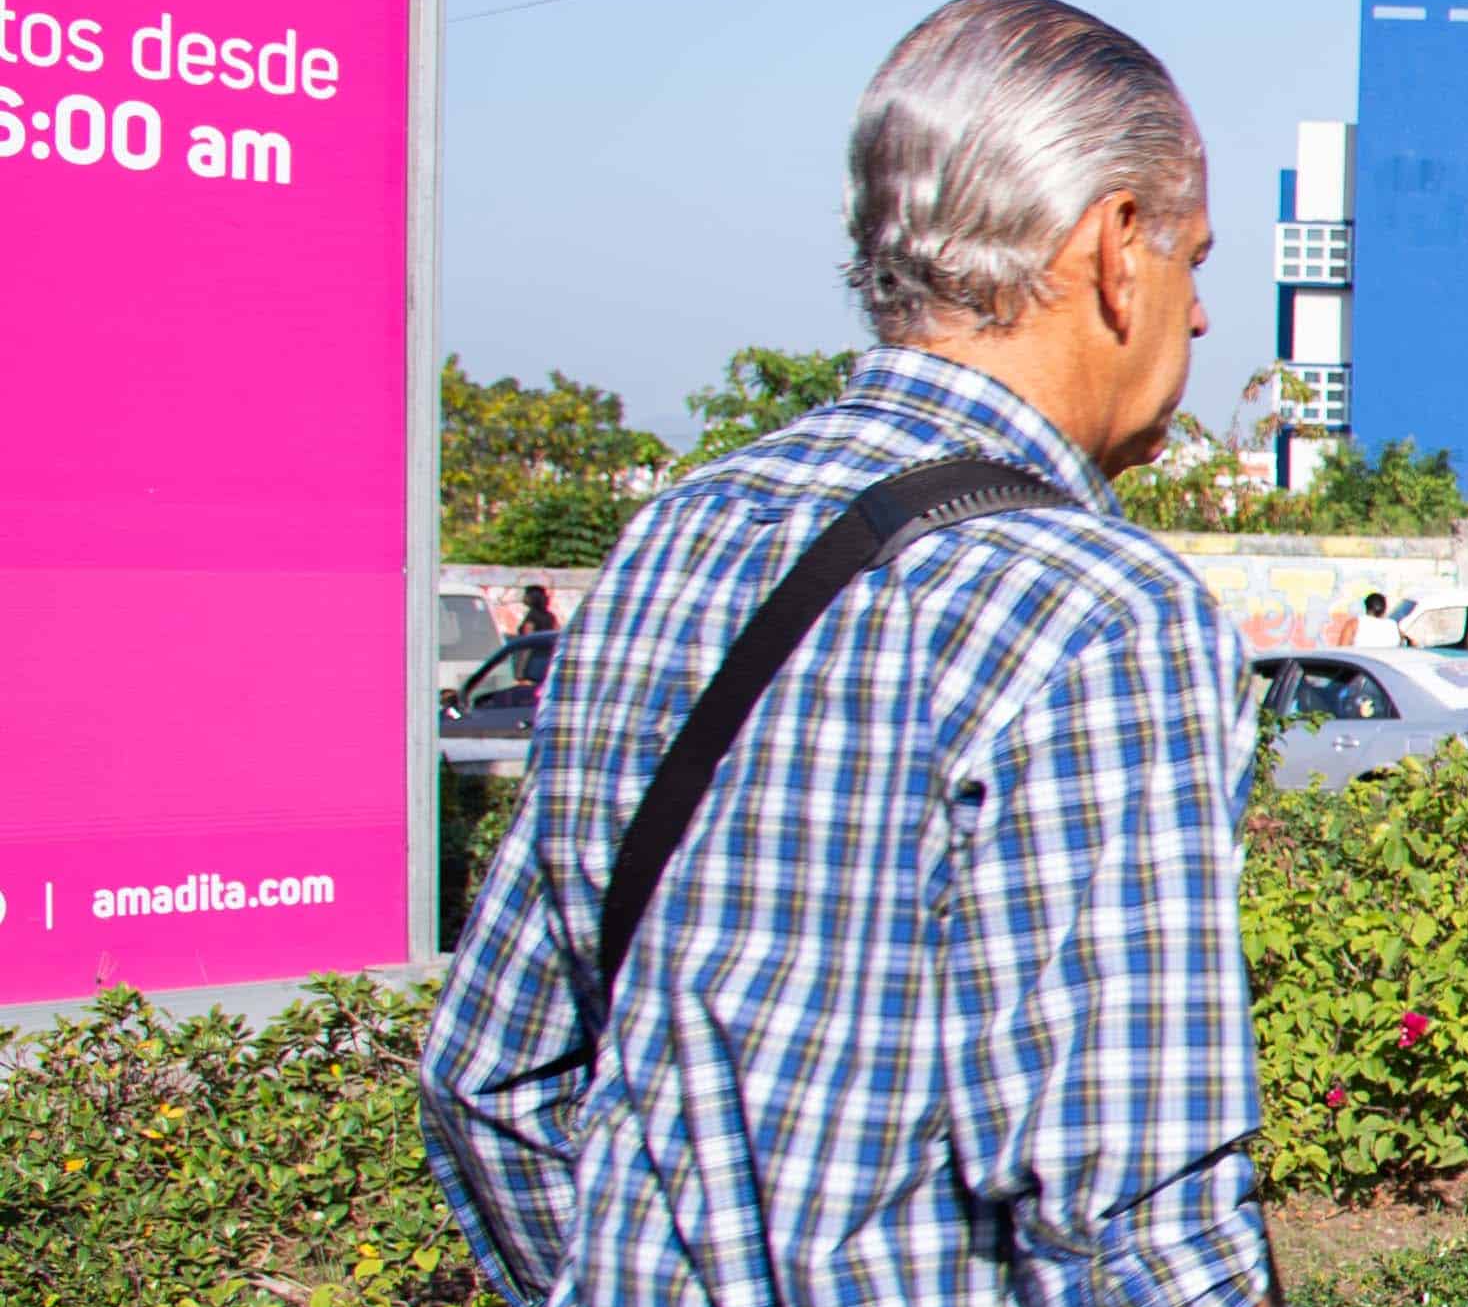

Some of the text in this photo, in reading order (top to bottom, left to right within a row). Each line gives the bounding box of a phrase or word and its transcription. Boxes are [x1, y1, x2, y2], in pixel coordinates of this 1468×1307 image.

[131, 12, 339, 100] desde
[186, 123, 292, 185] am
[92, 872, 335, 919] amadita.com
